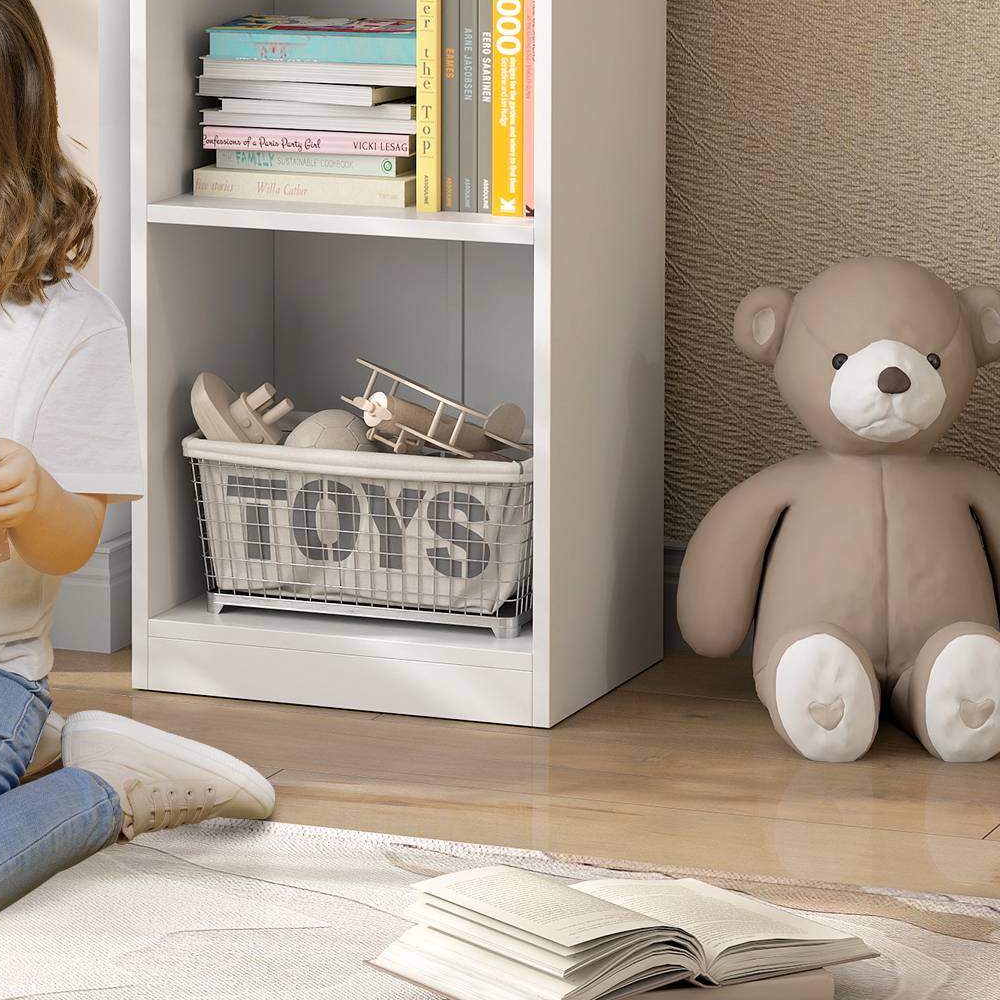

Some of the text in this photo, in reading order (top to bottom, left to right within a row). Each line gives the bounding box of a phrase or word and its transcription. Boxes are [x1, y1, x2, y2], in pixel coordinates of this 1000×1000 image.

[422, 48, 431, 90] the
[445, 48, 455, 79] EAMES
[463, 27, 473, 101] ARNE JACOBSEN
[482, 31, 492, 103] EERO SAARINEN
[203, 134, 241, 148] Confessions
[242, 136, 252, 149] of
[258, 136, 279, 149] Paris
[281, 137, 303, 152] Party
[304, 137, 321, 150] Girl
[353, 140, 377, 151] VICKI
[421, 105, 432, 155] Top
[235, 151, 276, 164] FAMILY
[277, 156, 318, 167] SUSTAINABLE
[320, 159, 353, 169] COOKBOOK
[256, 181, 281, 195] Willa
[226, 474, 491, 579] TOYS
